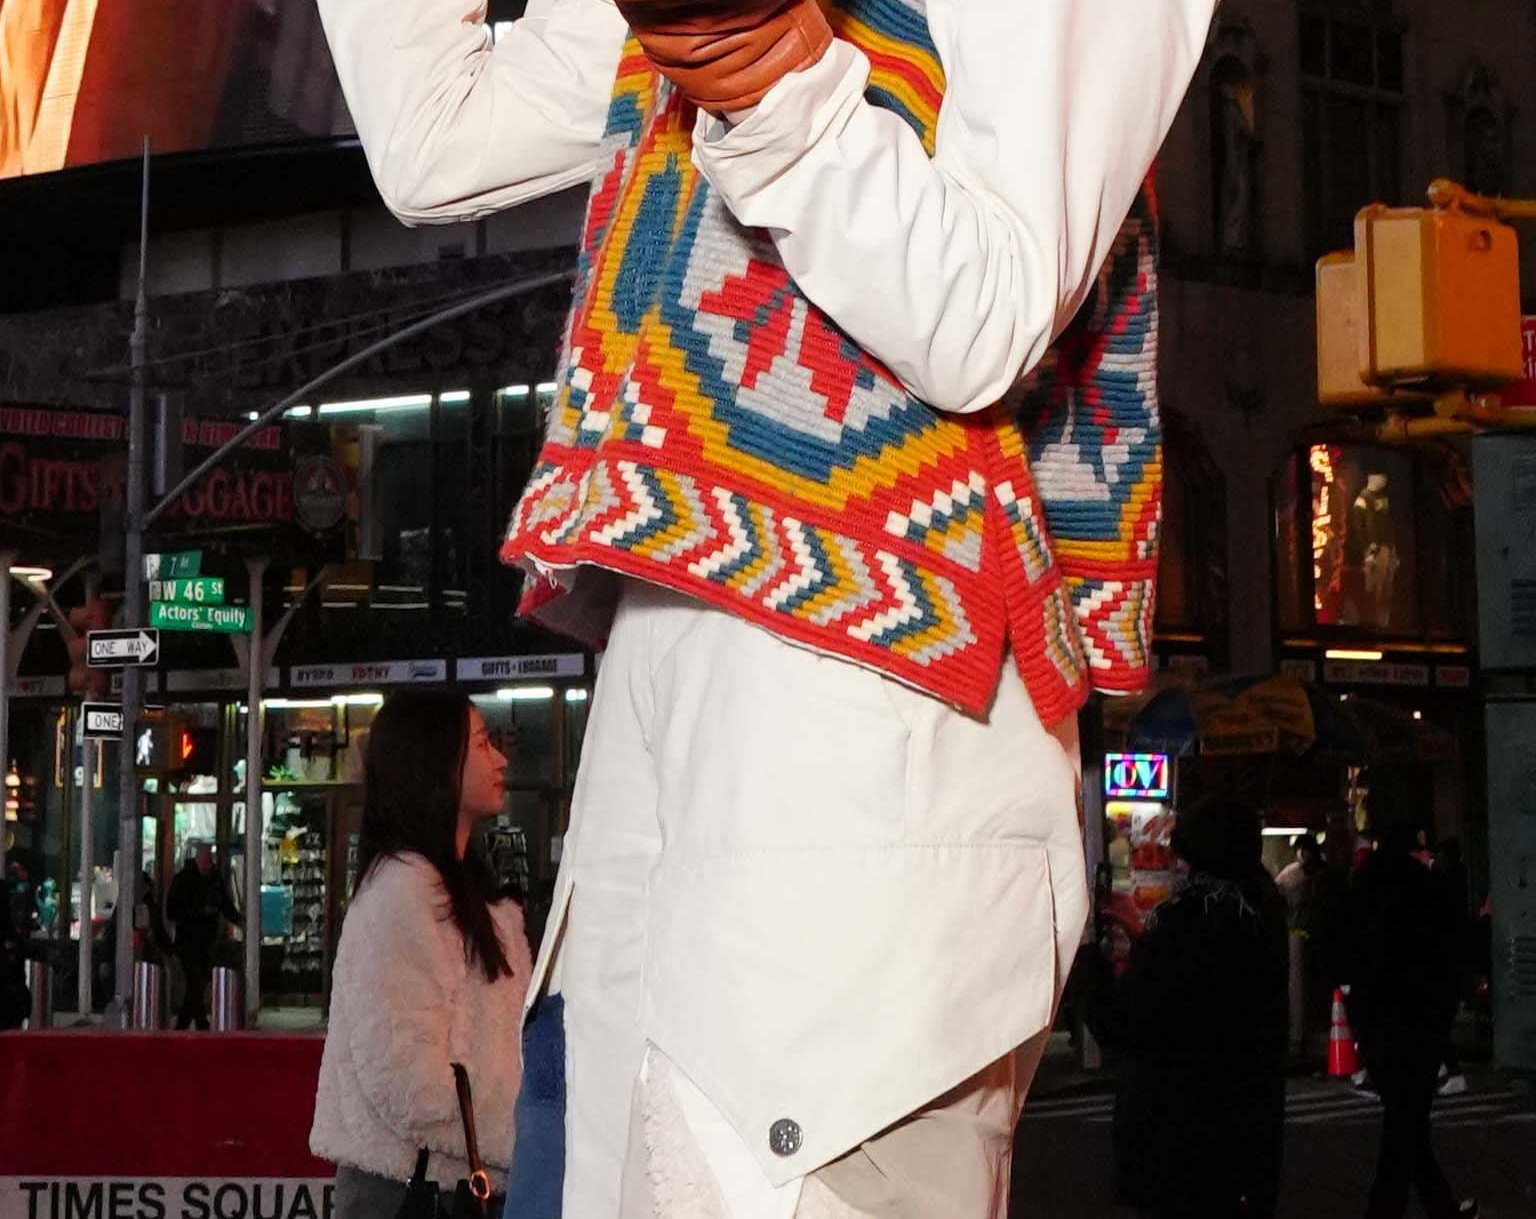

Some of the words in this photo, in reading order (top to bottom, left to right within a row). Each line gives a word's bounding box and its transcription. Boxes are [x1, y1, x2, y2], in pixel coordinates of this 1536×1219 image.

[163, 581, 177, 601] W
[183, 581, 205, 602] 46
[211, 578, 224, 595] St
[208, 607, 246, 627] Equity
[94, 641, 116, 655] ONE
[126, 640, 149, 654] WAY
[19, 1182, 165, 1219] TIMES
